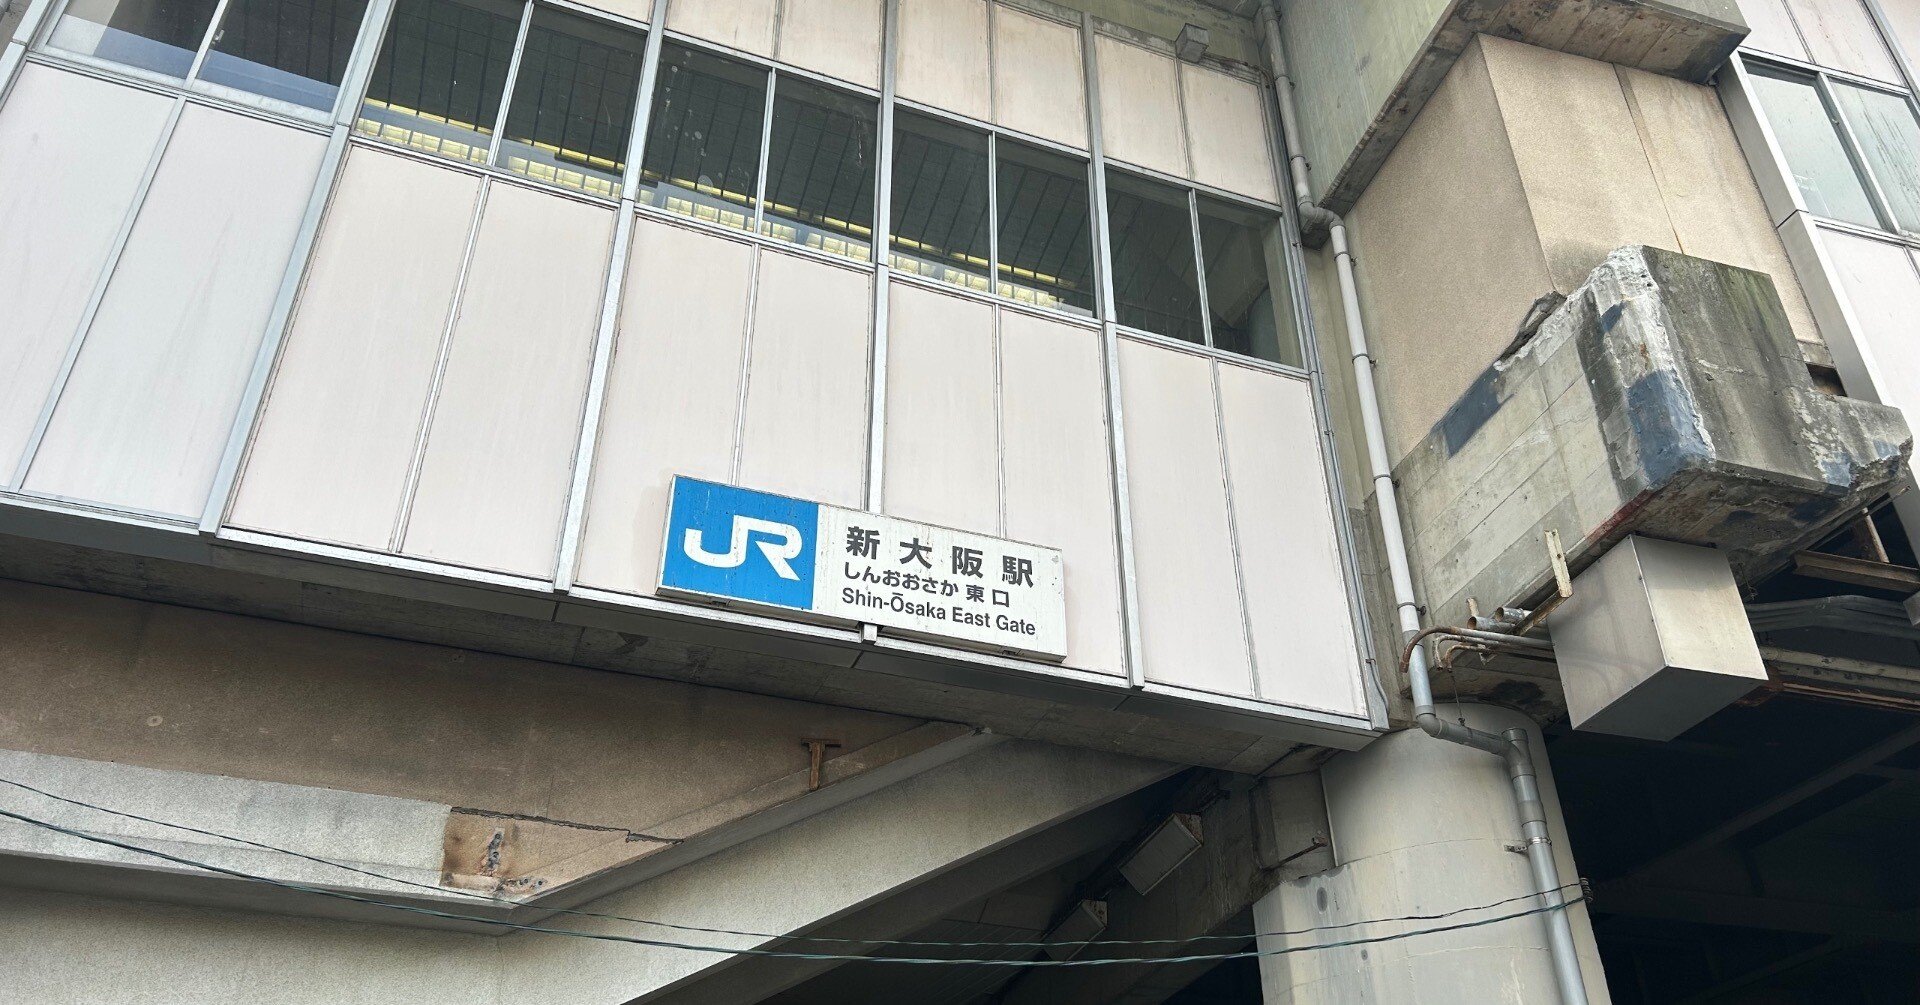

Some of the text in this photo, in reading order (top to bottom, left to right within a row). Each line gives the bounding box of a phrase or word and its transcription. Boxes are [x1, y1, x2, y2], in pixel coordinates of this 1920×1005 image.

[683, 514, 803, 581] JR
[845, 525, 1034, 588] 新大阪駅
[951, 607, 991, 629] East
[995, 614, 1037, 637] Gate
